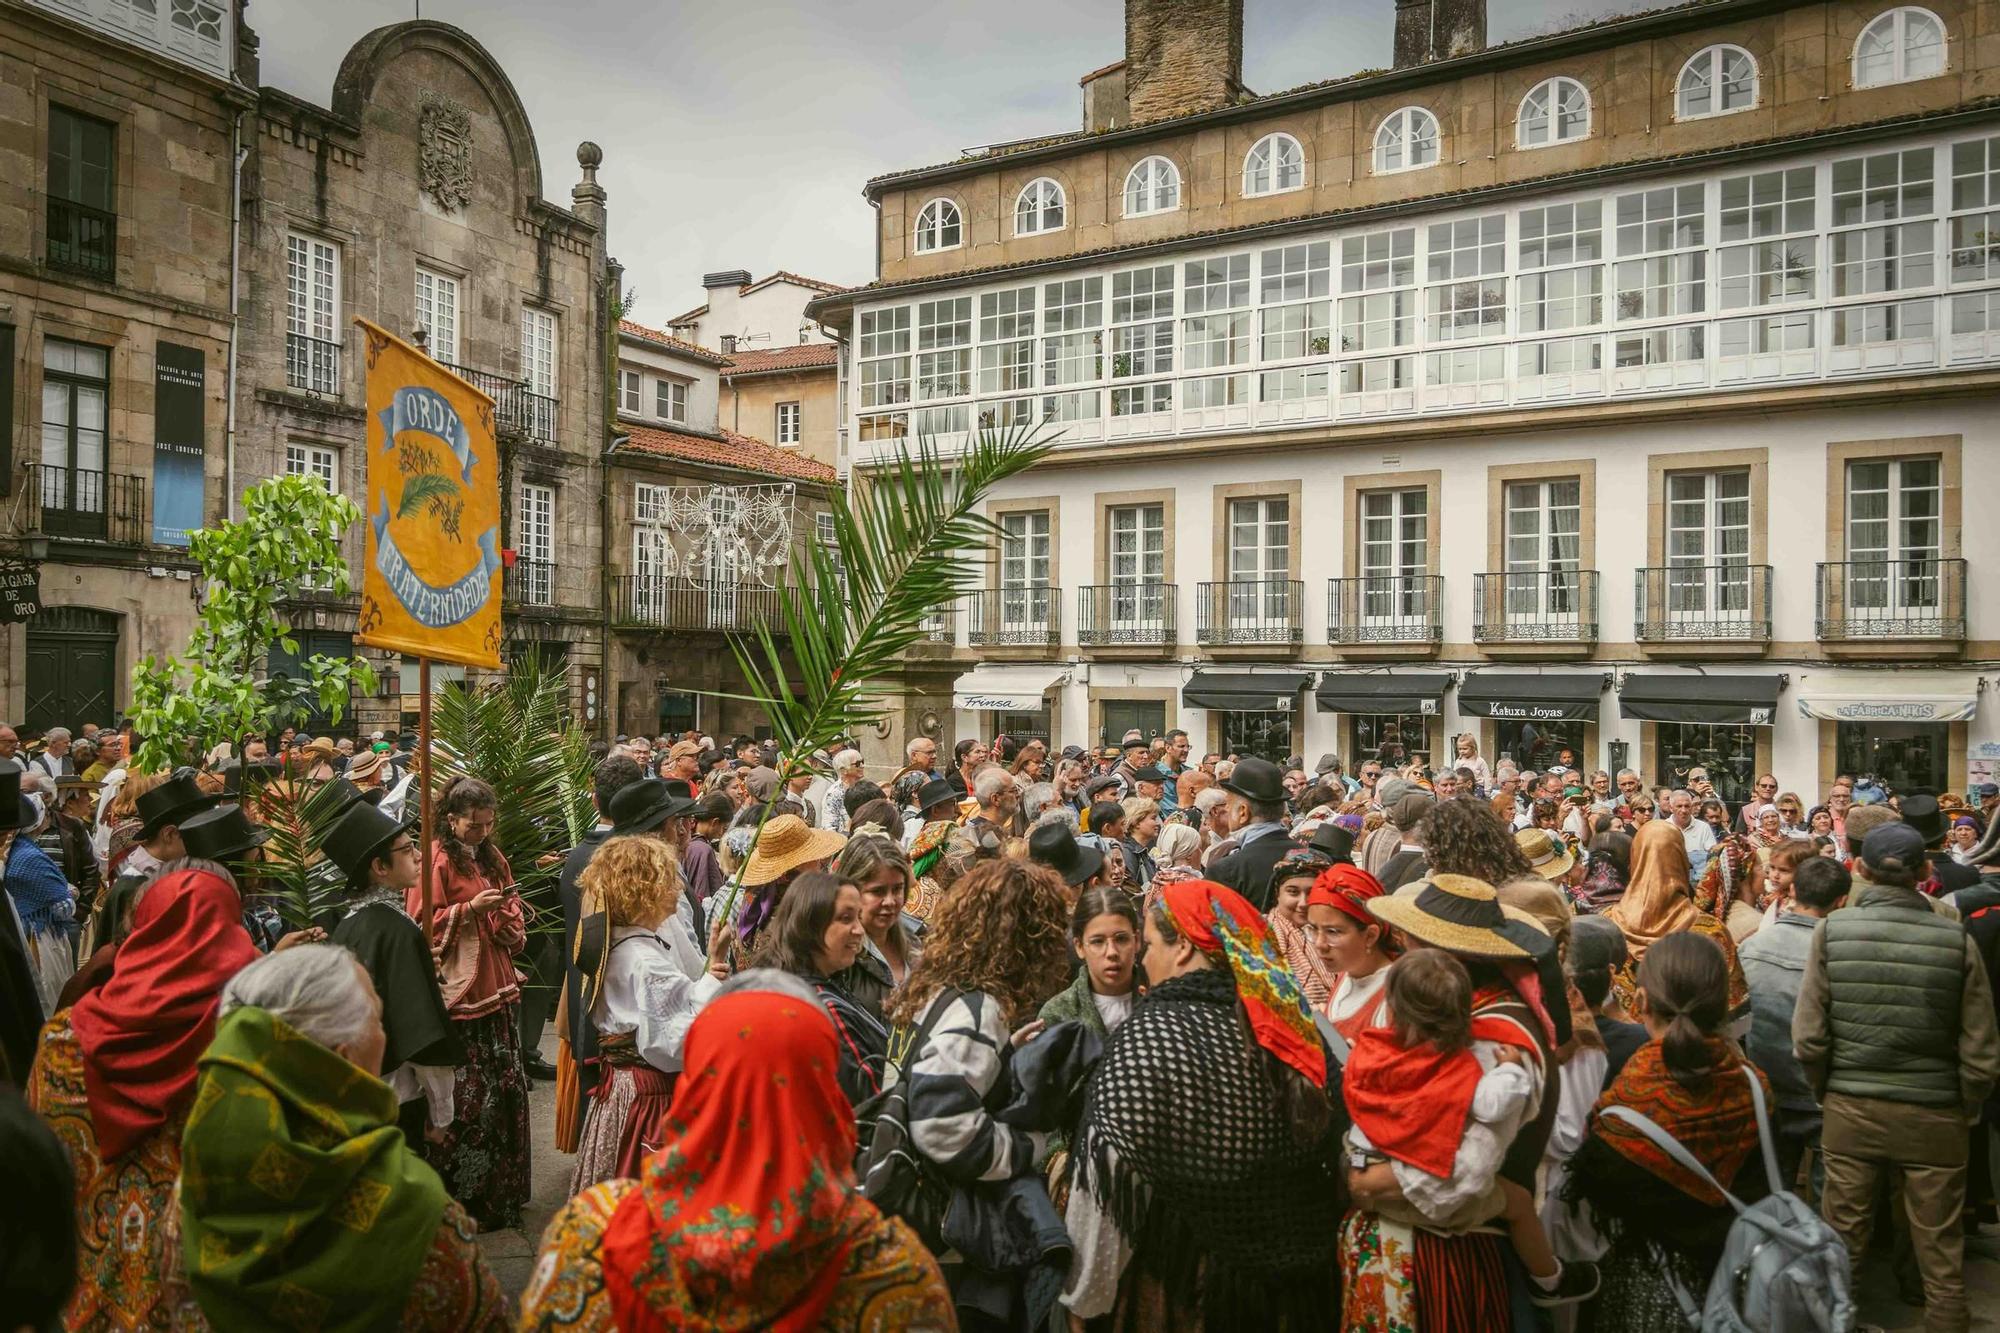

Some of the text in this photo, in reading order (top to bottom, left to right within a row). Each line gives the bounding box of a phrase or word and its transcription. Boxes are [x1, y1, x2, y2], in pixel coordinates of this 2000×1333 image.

[407, 393, 457, 447] ORDE
[175, 445, 203, 456] LORENZO
[0, 573, 36, 588] A GAFA
[75, 575, 82, 585] 9
[5, 590, 20, 601] DE
[14, 602, 36, 616] ORO
[964, 695, 1018, 708] Frinsa
[1489, 702, 1563, 719] Katuxa Joyas
